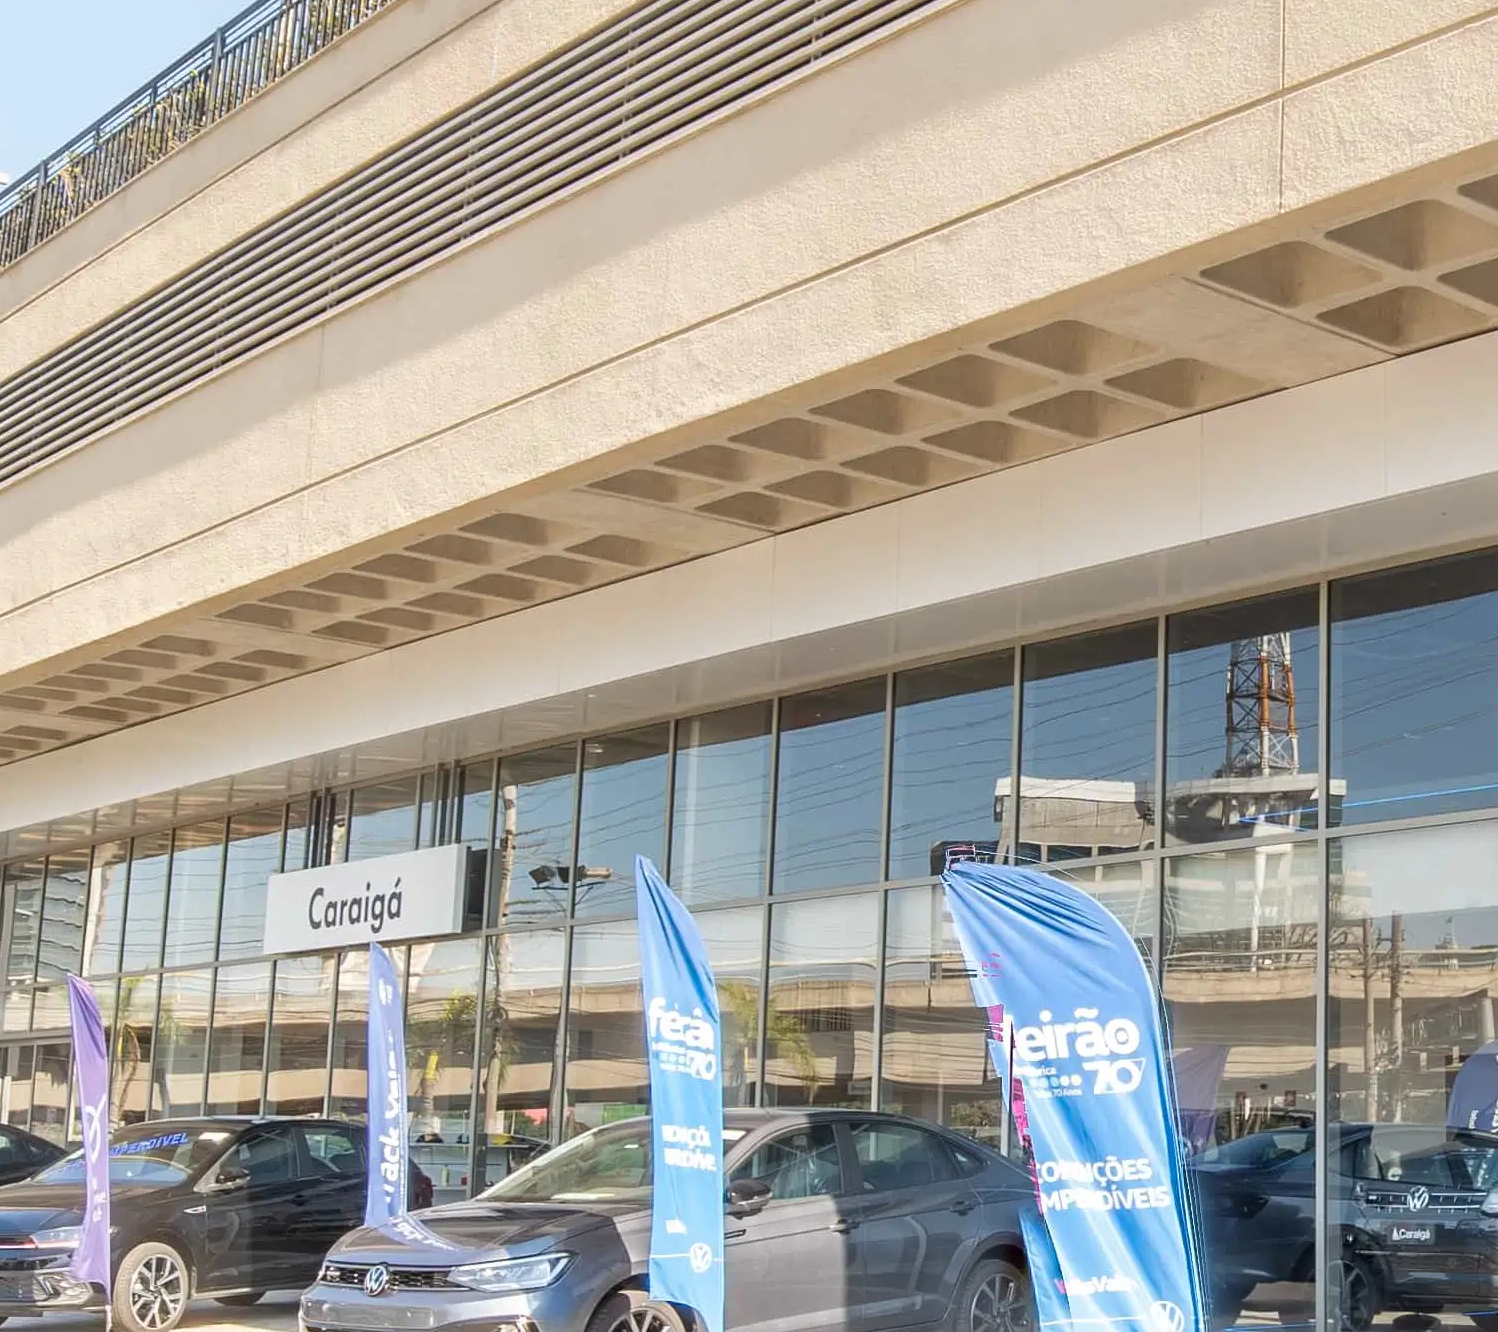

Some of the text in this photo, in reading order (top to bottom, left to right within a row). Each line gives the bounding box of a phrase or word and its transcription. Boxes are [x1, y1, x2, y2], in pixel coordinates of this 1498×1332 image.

[308, 876, 402, 934] Caraigá
[1081, 1058, 1147, 1095] 70
[109, 1132, 188, 1158] MPERDIVEL
[1039, 1185, 1171, 1210] MPDÍVEIS
